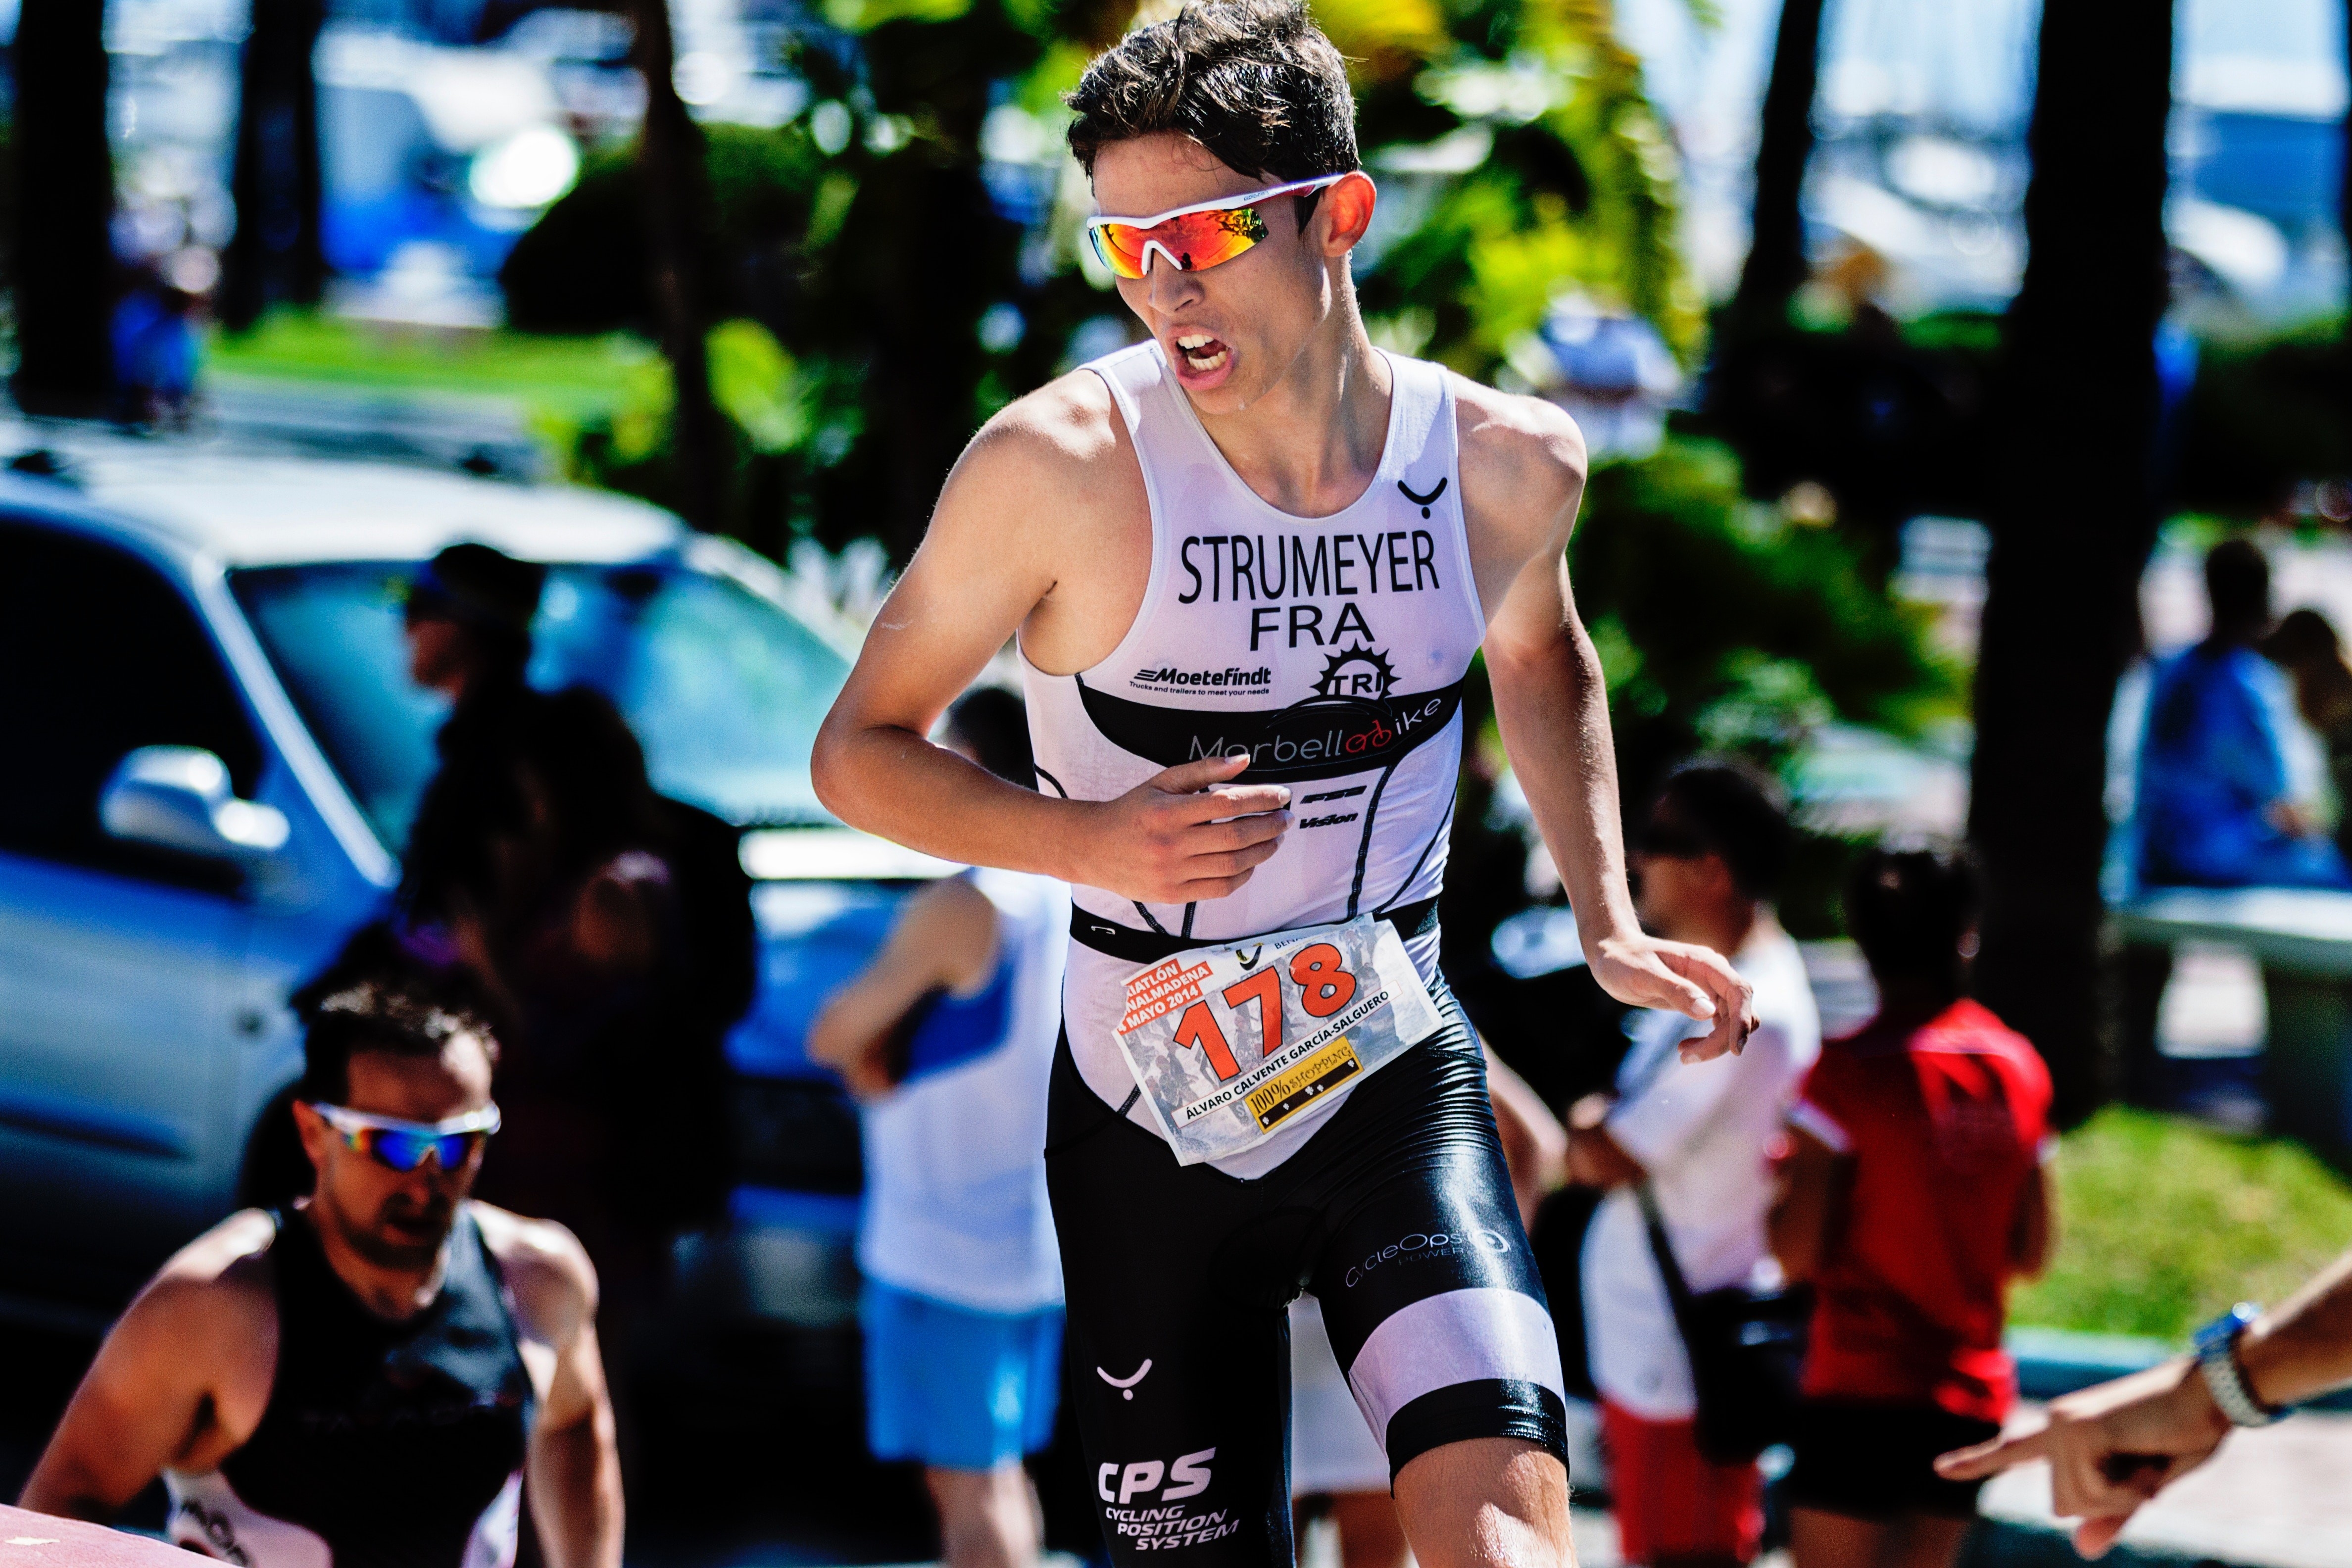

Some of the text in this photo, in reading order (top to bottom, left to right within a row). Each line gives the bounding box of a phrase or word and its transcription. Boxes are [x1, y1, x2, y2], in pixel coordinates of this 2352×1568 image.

[1178, 530, 1440, 604] STRUMEYER
[1250, 602, 1375, 651] FRA
[1129, 681, 1153, 691] Trucks
[1154, 666, 1271, 686] Moetefindt
[1328, 672, 1382, 695] TRI
[1299, 813, 1359, 829] Vision
[1126, 1001, 1166, 1029] MAYO
[1166, 984, 1198, 1009] 2014
[1173, 943, 1357, 1082] 178
[1186, 991, 1388, 1120] ÁLVARO CALVENTE GARCÍA-SALGUERO
[1251, 1046, 1352, 1114] 100% SHOPPING
[1346, 1233, 1462, 1287] CycleOps
[1399, 1247, 1464, 1266] POWER
[1098, 1447, 1216, 1504] CPS
[1106, 1505, 1185, 1522] CYCLING
[1117, 1508, 1227, 1536] POSITION
[1135, 1519, 1240, 1550] SYSTEM
